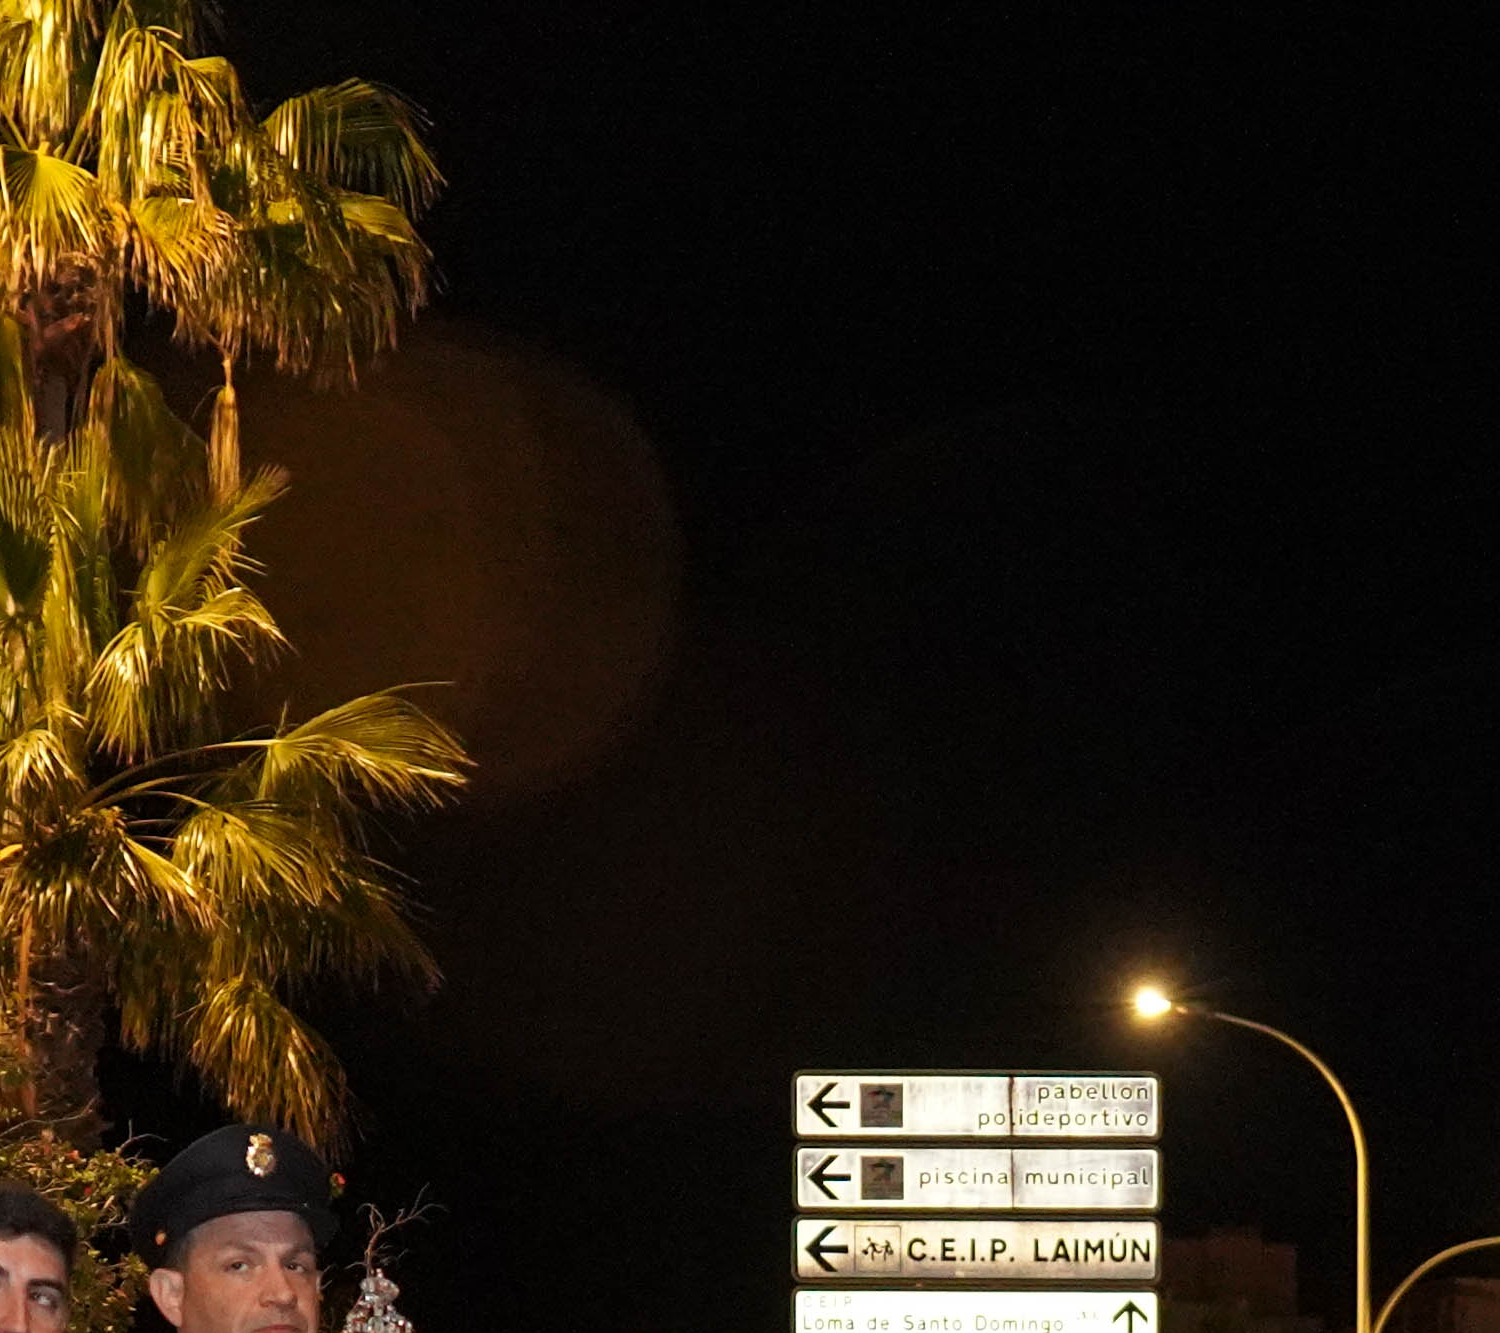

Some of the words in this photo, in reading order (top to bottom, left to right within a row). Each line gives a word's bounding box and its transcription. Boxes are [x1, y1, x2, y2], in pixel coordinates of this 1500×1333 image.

[978, 1110, 1148, 1130] polideportivo
[920, 1167, 1008, 1189] piscina
[1025, 1168, 1148, 1189] municipal
[907, 1238, 1015, 1262] C.E.I.P.
[1033, 1232, 1150, 1262] LAIMÚN
[803, 1315, 854, 1330] Loma
[867, 1316, 889, 1330] de
[903, 1314, 962, 1330] Santo
